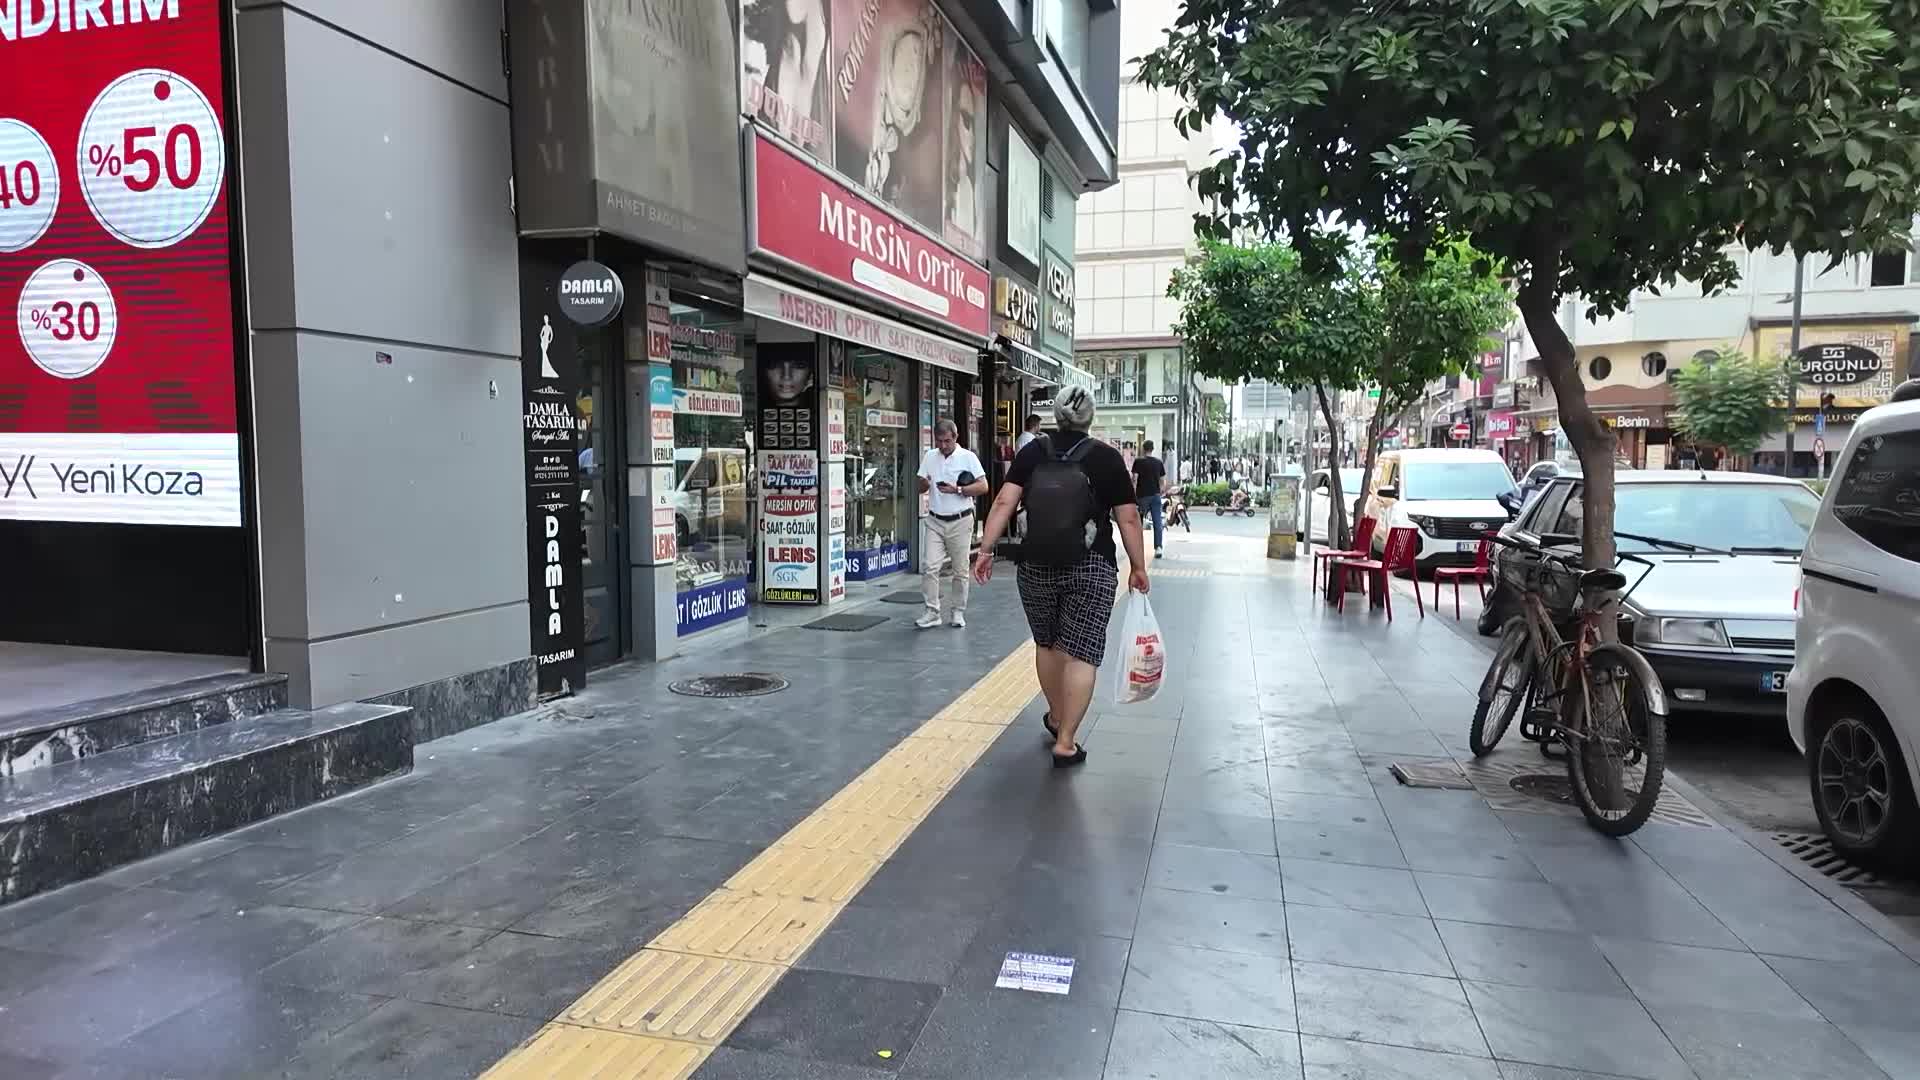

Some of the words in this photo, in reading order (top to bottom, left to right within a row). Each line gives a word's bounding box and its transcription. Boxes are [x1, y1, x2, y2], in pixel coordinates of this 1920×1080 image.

[89, 123, 202, 193] %50
[561, 279, 613, 294] DAMLA
[570, 297, 604, 305] TASARIM
[31, 301, 100, 341] %30
[1799, 360, 1881, 373] URGUNLU
[1812, 372, 1856, 383] GOLD
[1152, 396, 1178, 404] CEMO
[529, 402, 570, 417] DAMLA
[524, 415, 575, 429] TASARIM
[1617, 416, 1650, 428] Benim
[766, 496, 792, 511] MERSİN
[794, 496, 816, 512] OPTİK
[655, 533, 676, 561] LENS
[768, 547, 816, 563] LENS
[843, 558, 860, 573] NS
[545, 515, 563, 635] DAMLA
[776, 571, 799, 583] SGK
[691, 591, 722, 620] GÖZLÜK
[728, 587, 746, 610] LENS
[538, 648, 575, 665] TASARIM
